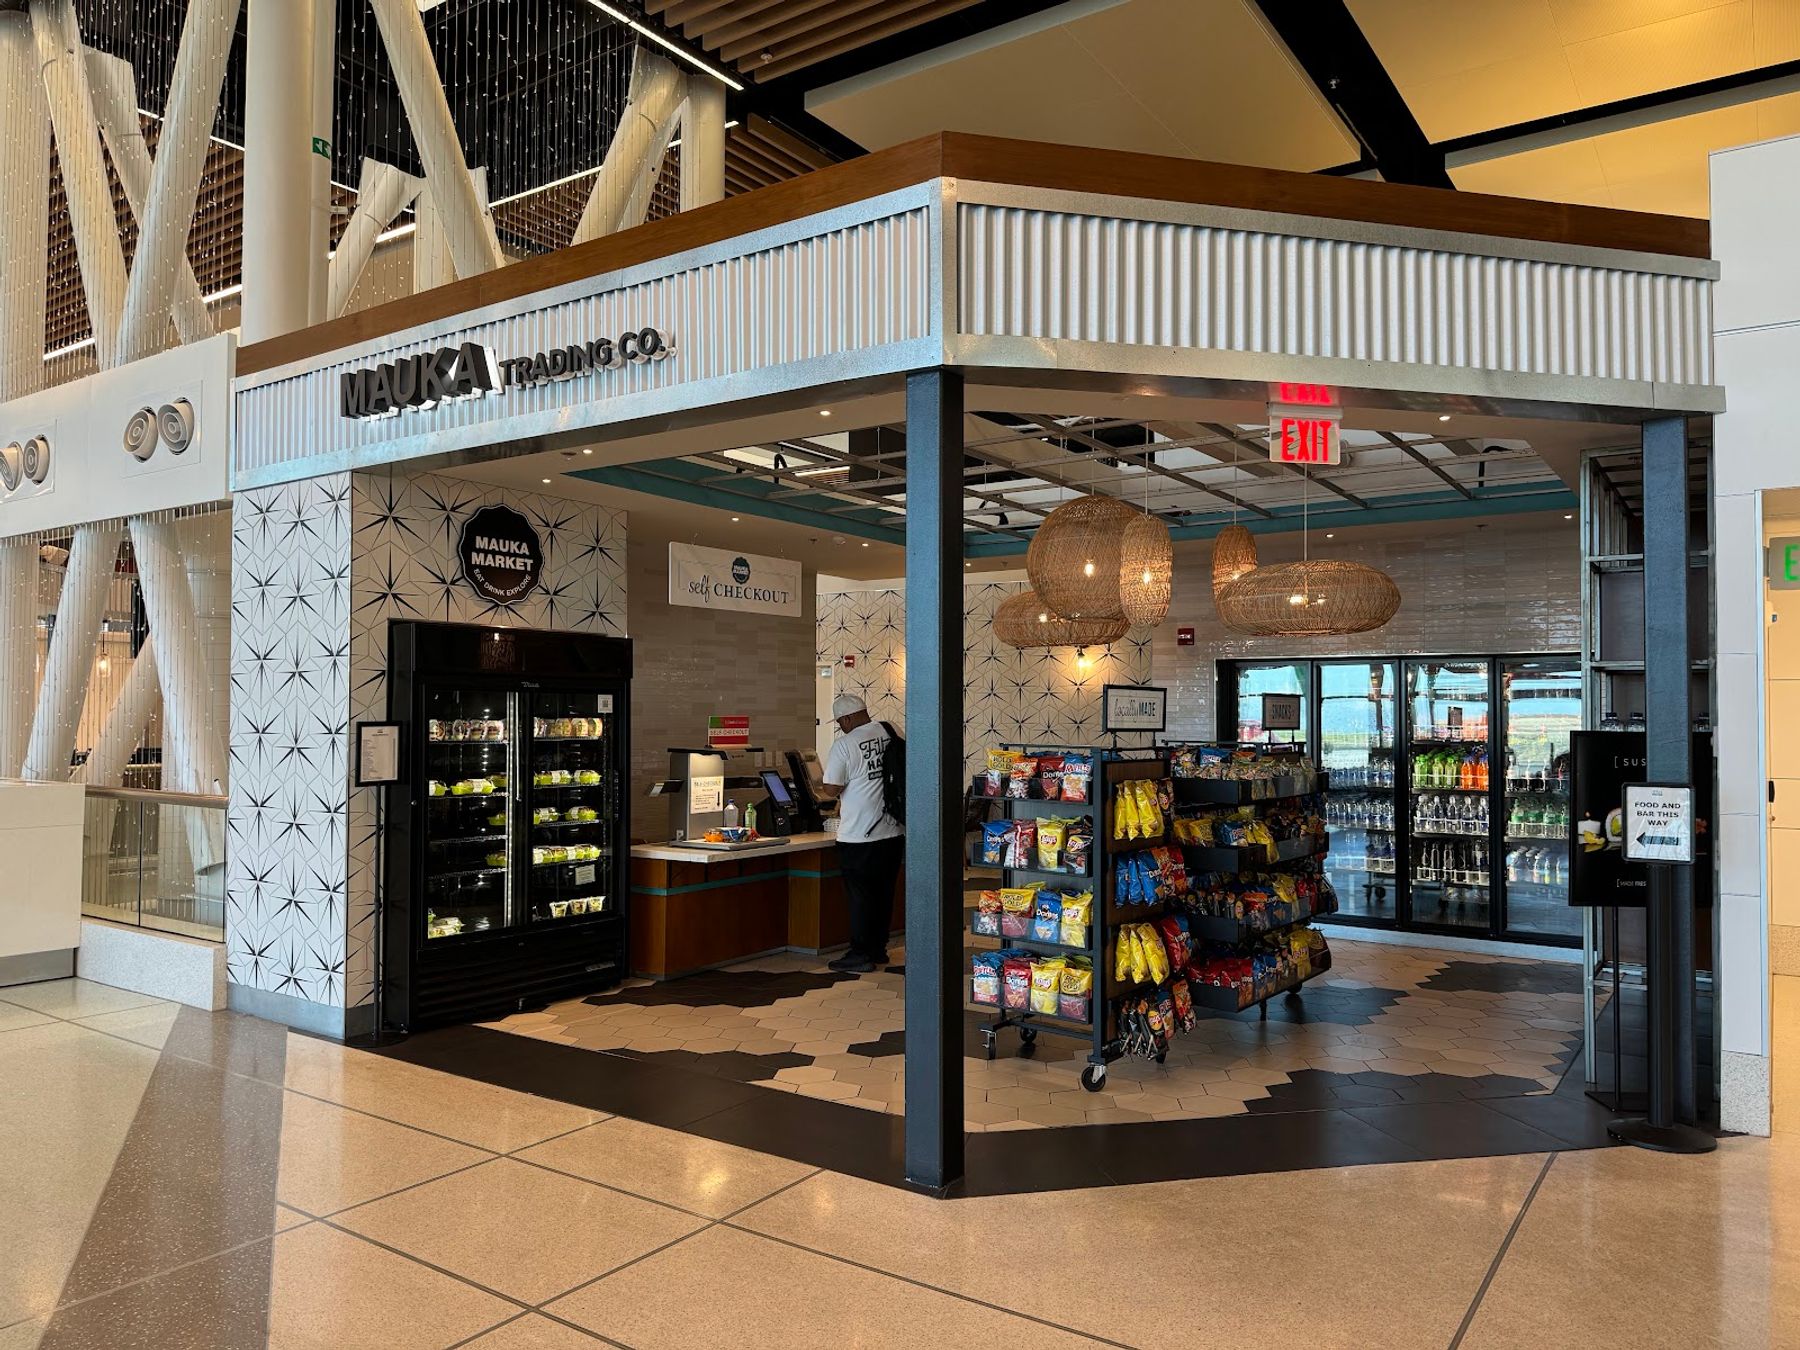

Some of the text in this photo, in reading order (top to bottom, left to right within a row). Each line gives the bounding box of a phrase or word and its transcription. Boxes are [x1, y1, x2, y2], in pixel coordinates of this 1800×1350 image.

[340, 327, 667, 418] MAUKA TRADING CO.
[1281, 418, 1332, 462] EXIT
[475, 535, 530, 556] MAUKA
[471, 551, 534, 572] MARKET
[473, 568, 532, 597] EAT DRINK EXPLORE
[688, 574, 789, 604] self CHECKOUT
[1623, 758, 1647, 767] SUS
